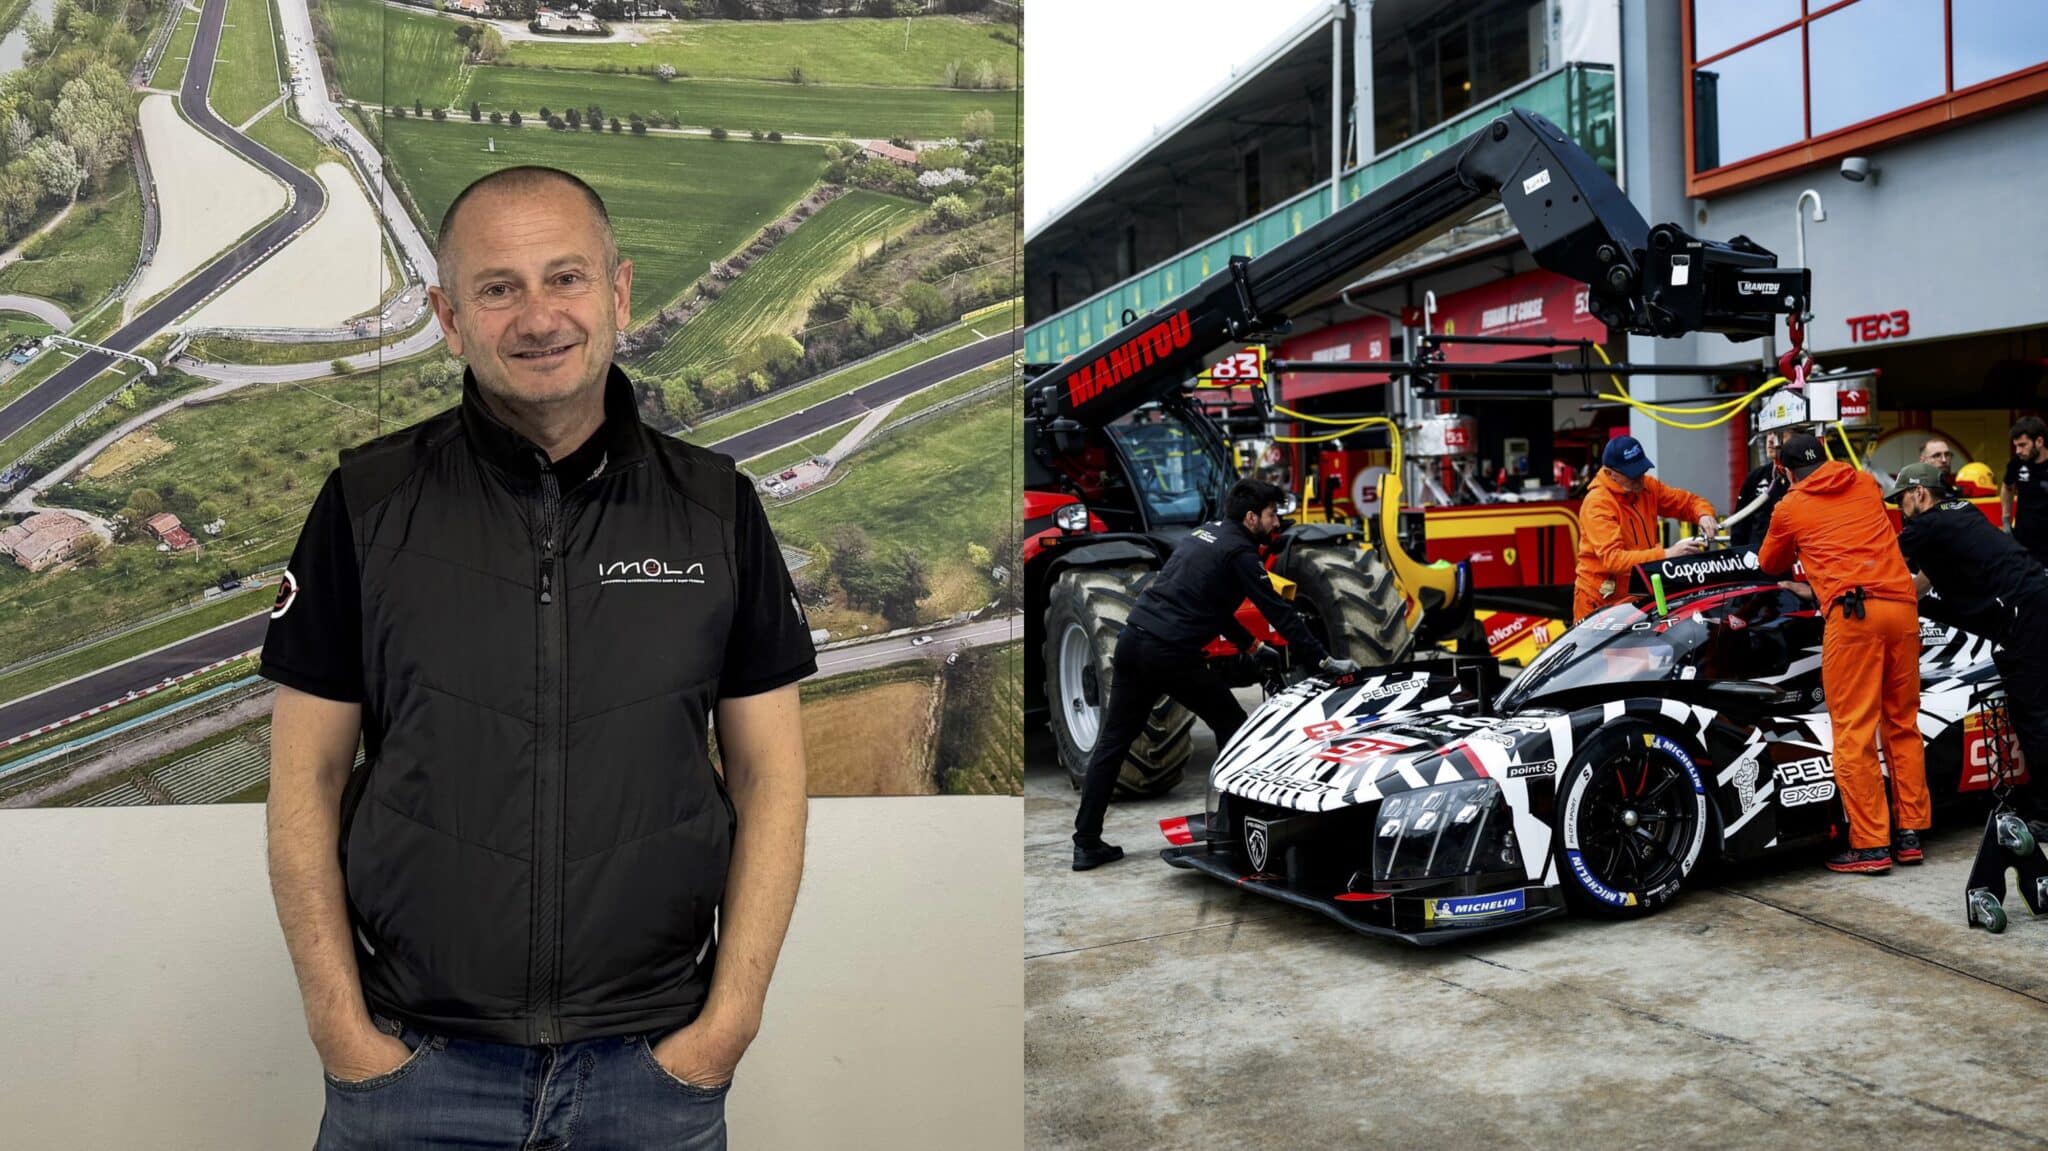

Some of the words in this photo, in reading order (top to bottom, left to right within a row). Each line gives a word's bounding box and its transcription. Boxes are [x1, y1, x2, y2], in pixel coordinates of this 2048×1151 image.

[1743, 282, 1780, 291] MANITOU
[1846, 309, 1910, 344] TEC3
[1067, 308, 1192, 409] MANITOU
[1212, 352, 1260, 382] 83
[1446, 431, 1465, 444] 51
[599, 558, 704, 577] IMOLA
[1662, 554, 1745, 583] Capgemini
[1361, 677, 1429, 702] PEUGEOT
[1661, 740, 1703, 789] MICHELIN
[1240, 768, 1340, 794] PEUGEOT
[1780, 780, 1836, 807] 9X8
[1571, 855, 1617, 901] MICHELIN
[1455, 897, 1517, 913] MICHELIN
